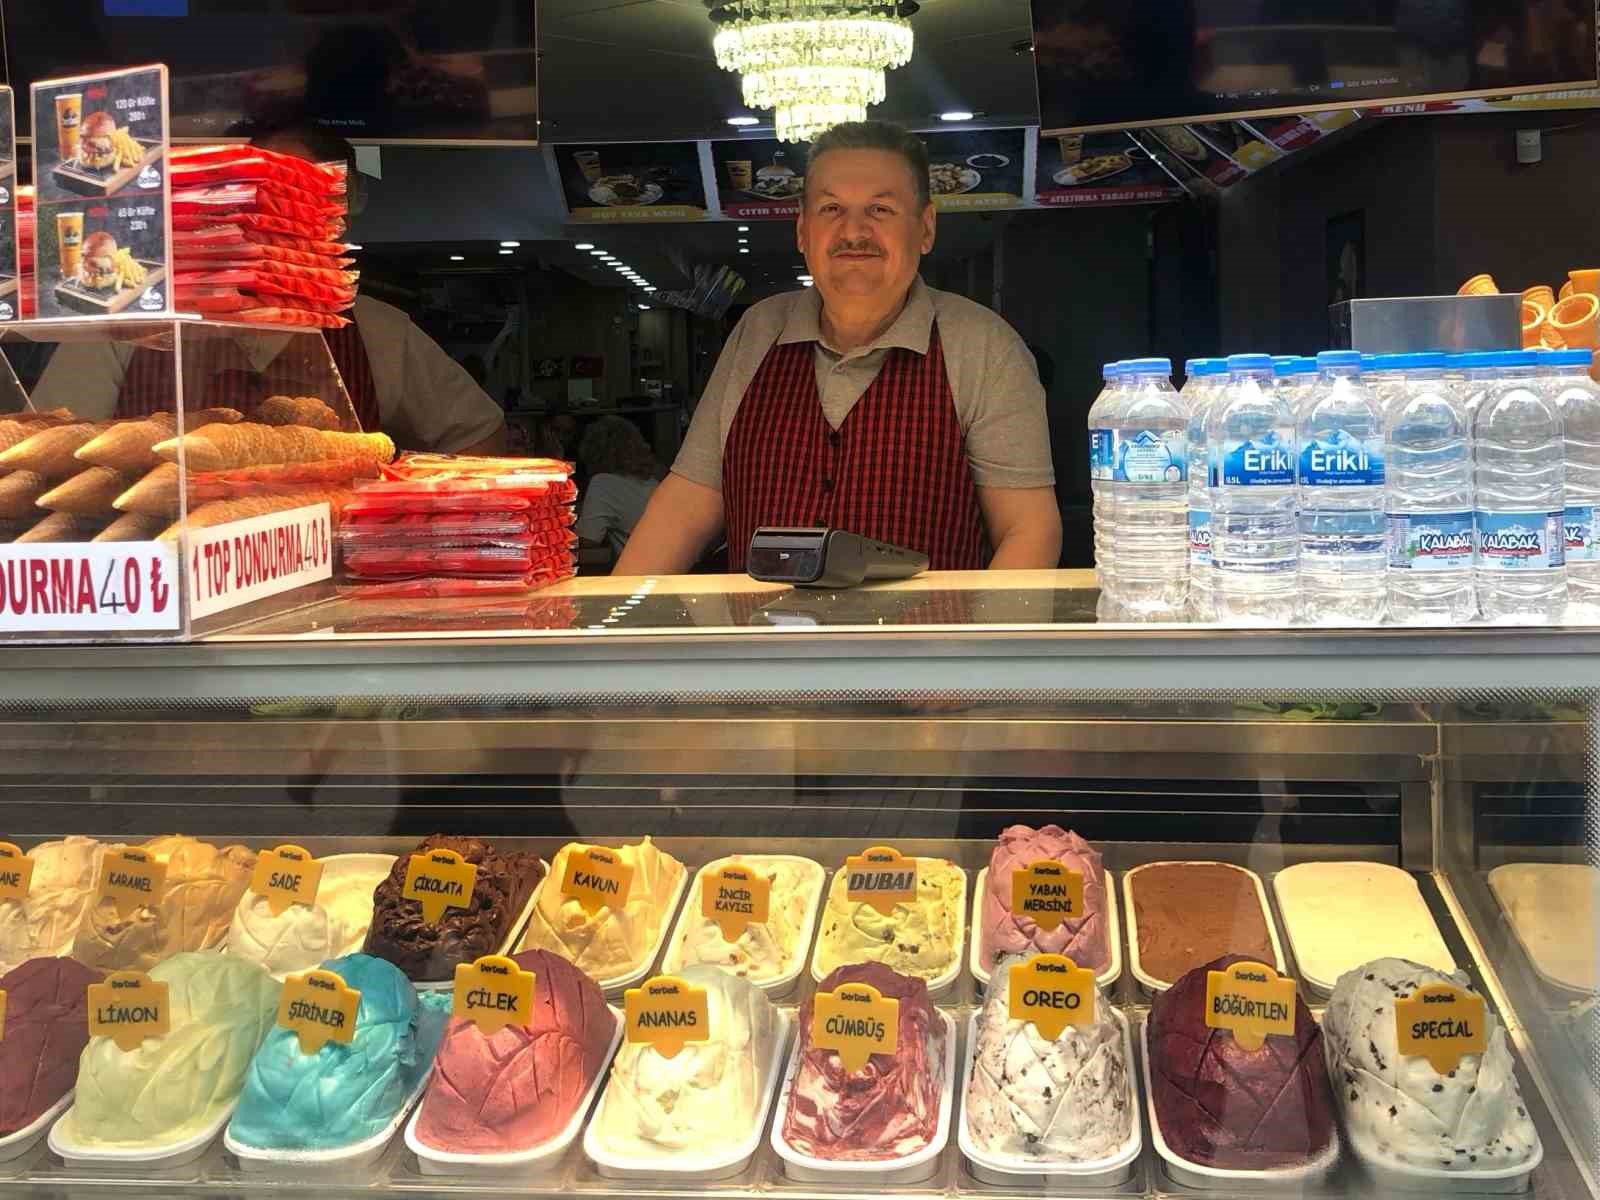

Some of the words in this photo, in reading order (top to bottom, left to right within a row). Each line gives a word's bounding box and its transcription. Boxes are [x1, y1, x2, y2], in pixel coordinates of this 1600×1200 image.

[1311, 449, 1369, 471] Erikli
[204, 538, 232, 599] TOP
[234, 523, 304, 590] DONDURMA
[108, 871, 153, 893] KARAMEL
[269, 871, 302, 893] SADE
[413, 875, 463, 896] ÇİKOLATA
[572, 870, 619, 895] KAVUN
[848, 871, 914, 891] DUBAI
[1029, 882, 1067, 897] YABAN
[1023, 898, 1073, 914] MERSİNİ
[465, 987, 518, 1012] ÇİLEK
[1022, 990, 1081, 1010] OREO
[1213, 994, 1288, 1022] BÖĞÜRTLEN
[97, 1002, 159, 1026] LİMON
[288, 1000, 345, 1029] ŞİRİNLER
[637, 1010, 697, 1028] ANANAS
[825, 1014, 886, 1043] CÜMBÜŞ
